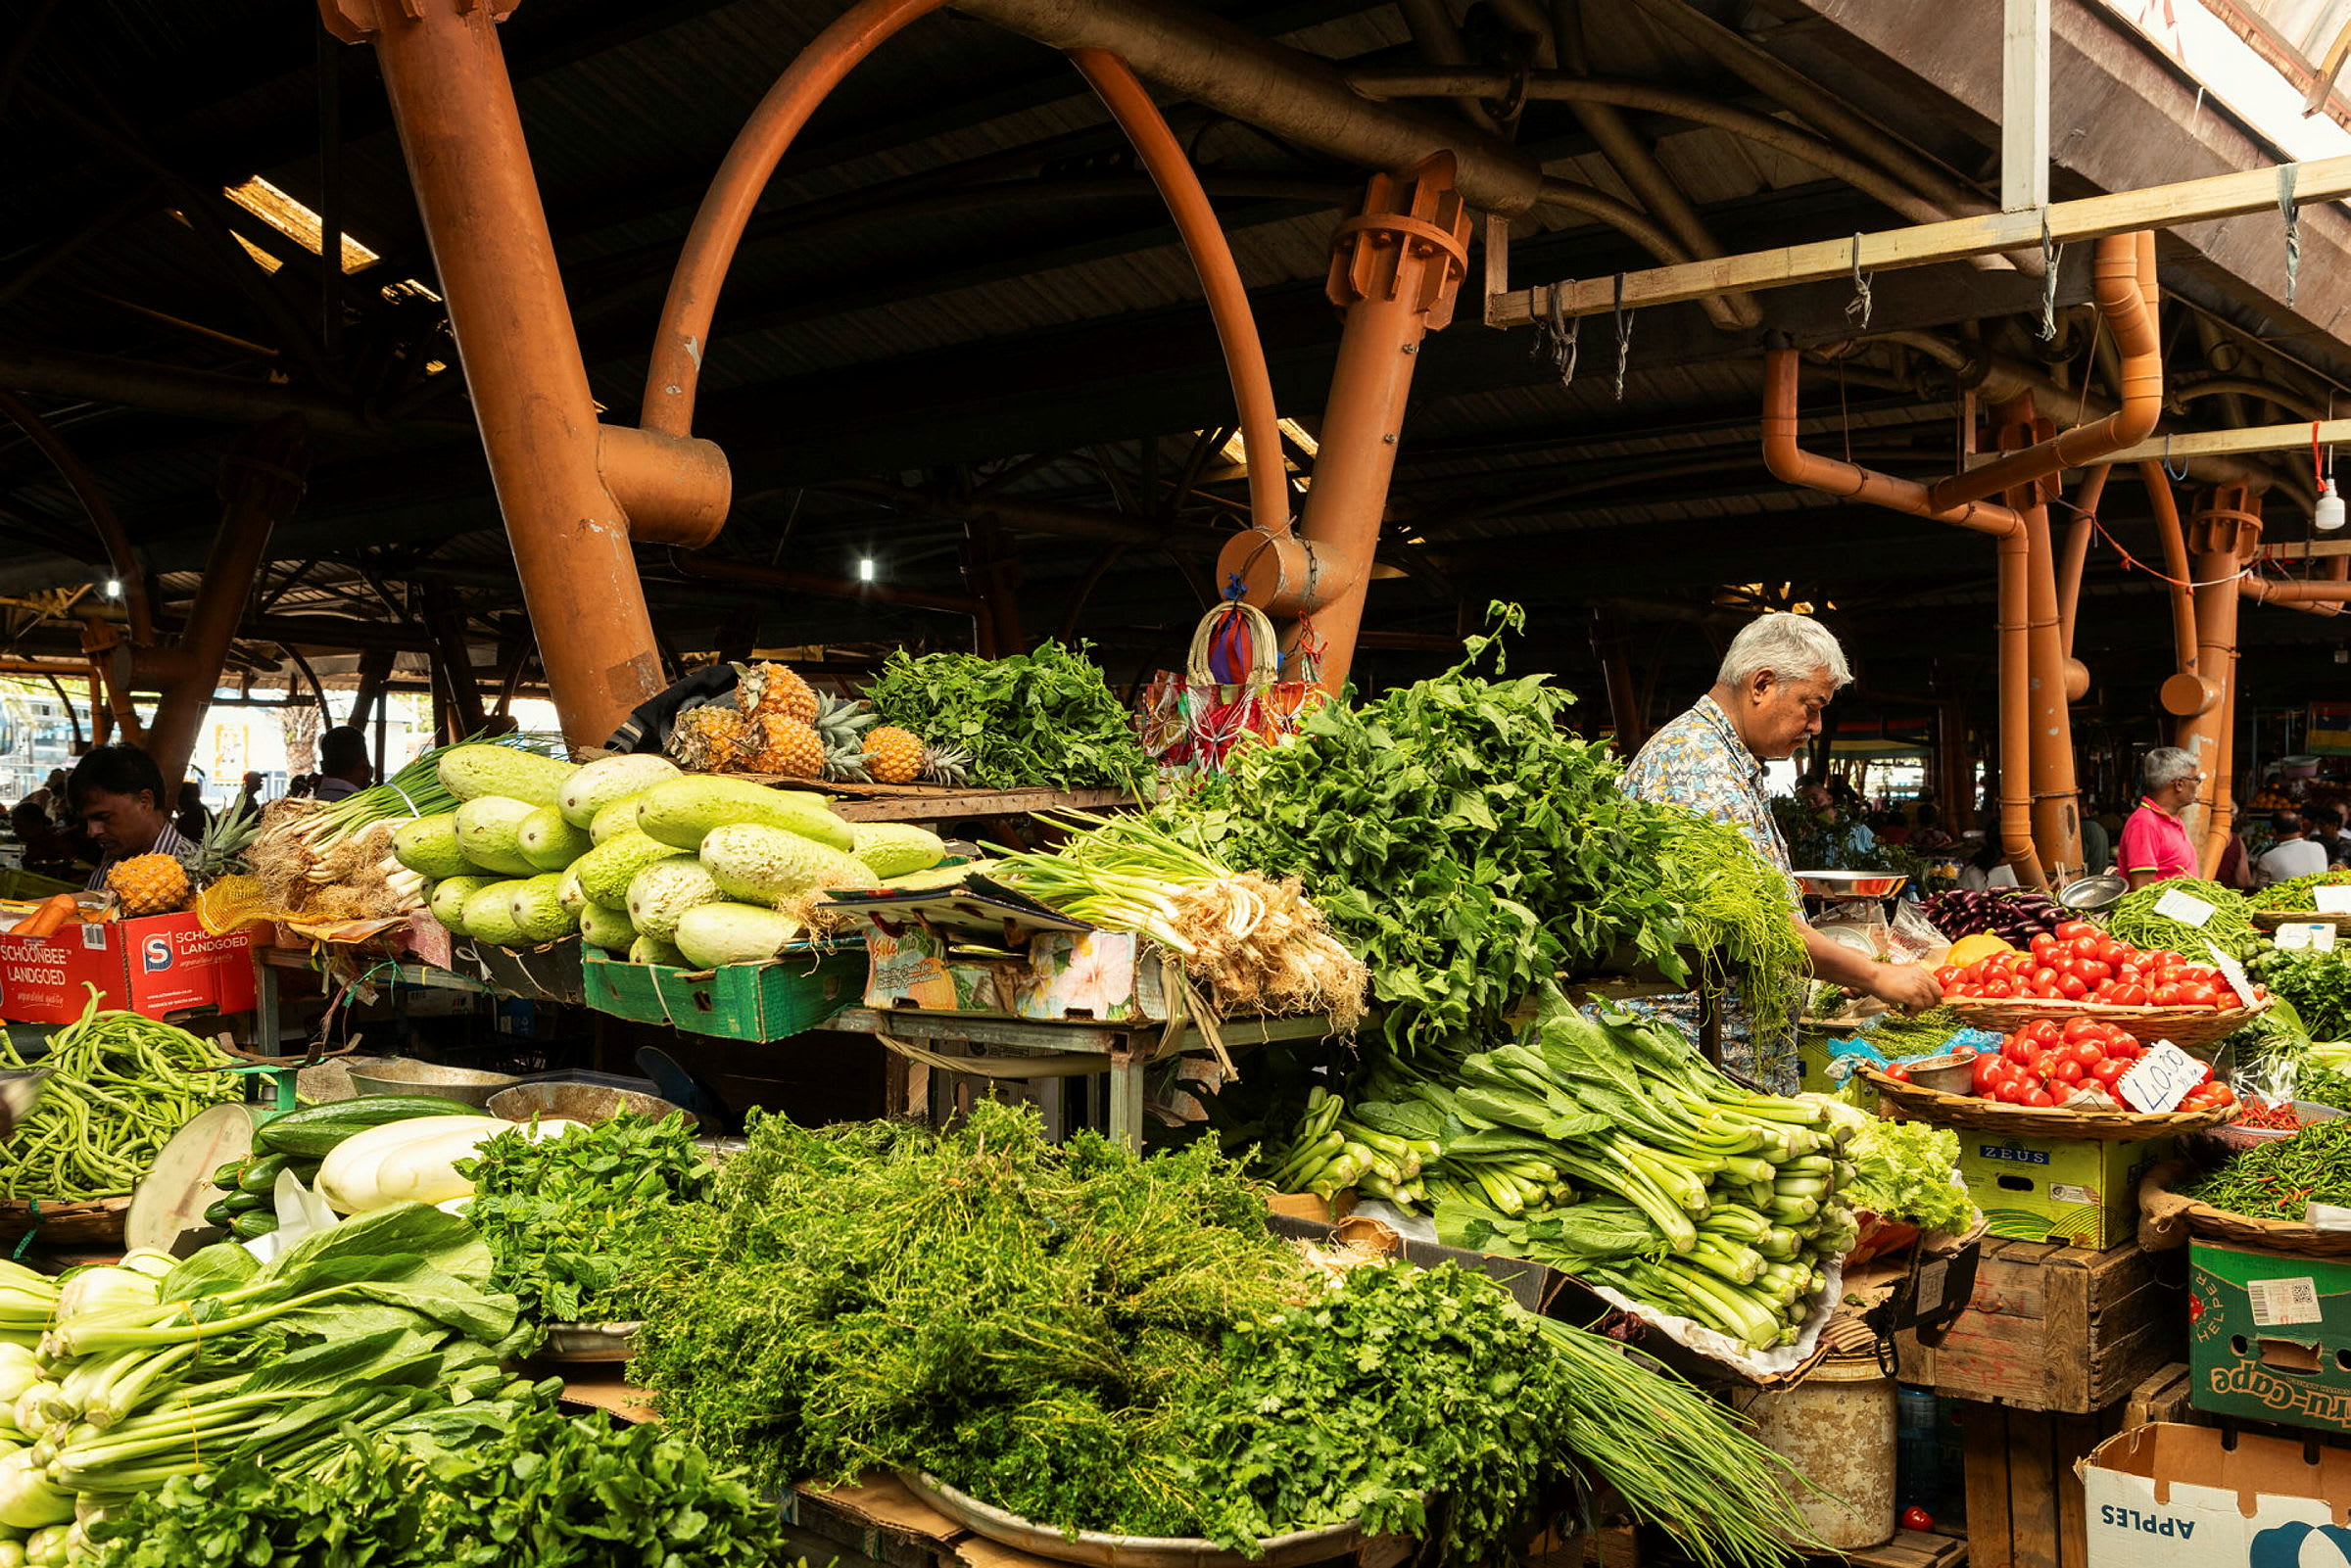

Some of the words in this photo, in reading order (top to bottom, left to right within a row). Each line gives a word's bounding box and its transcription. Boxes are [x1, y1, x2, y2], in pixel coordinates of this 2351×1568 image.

[0, 945, 67, 965] SCHOONBEE
[180, 936, 249, 955] LANDGOED
[7, 965, 66, 985] LANDGOED
[1985, 1147, 2044, 1164] ZEUS
[2195, 1273, 2225, 1344] HELPER
[2101, 1504, 2196, 1541] APPLES
